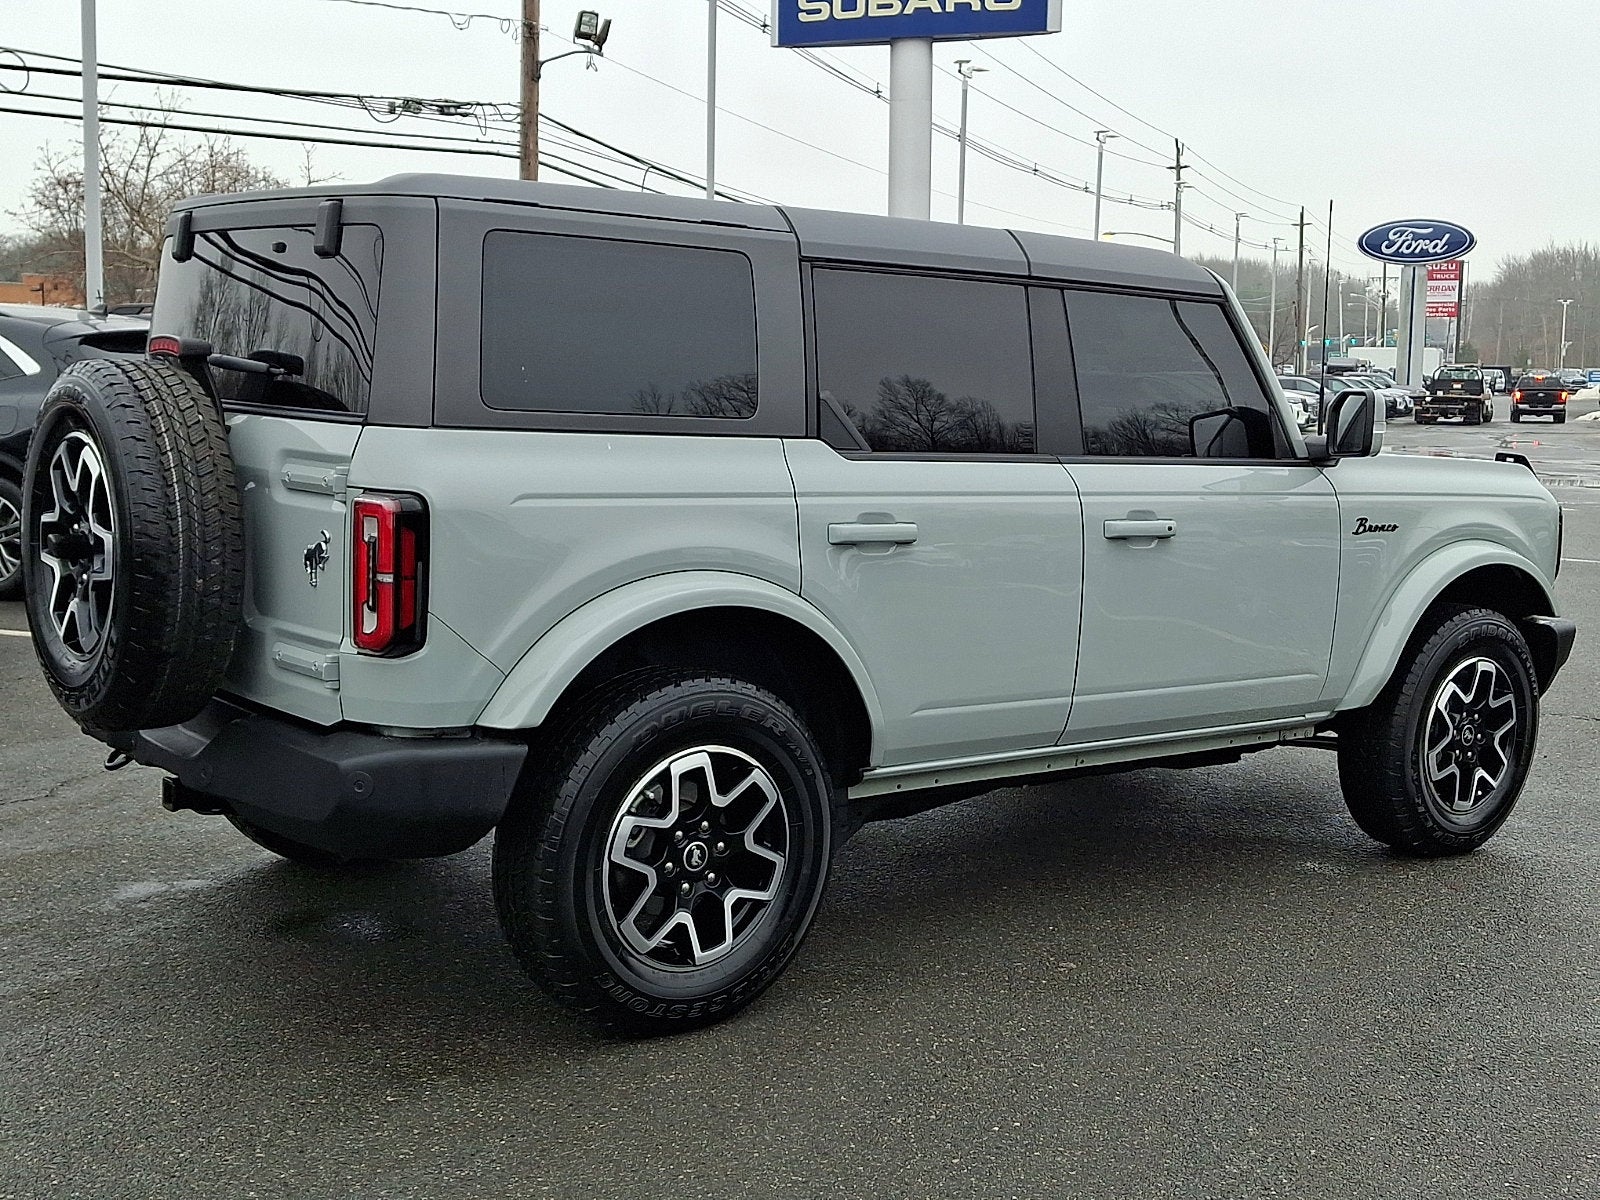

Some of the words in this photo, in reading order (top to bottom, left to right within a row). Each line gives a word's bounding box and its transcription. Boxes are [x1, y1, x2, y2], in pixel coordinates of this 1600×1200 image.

[797, 0, 1022, 22] SUB
[1381, 226, 1451, 254] Ford
[1426, 262, 1456, 270] SUZU
[1351, 516, 1399, 536] Bronco
